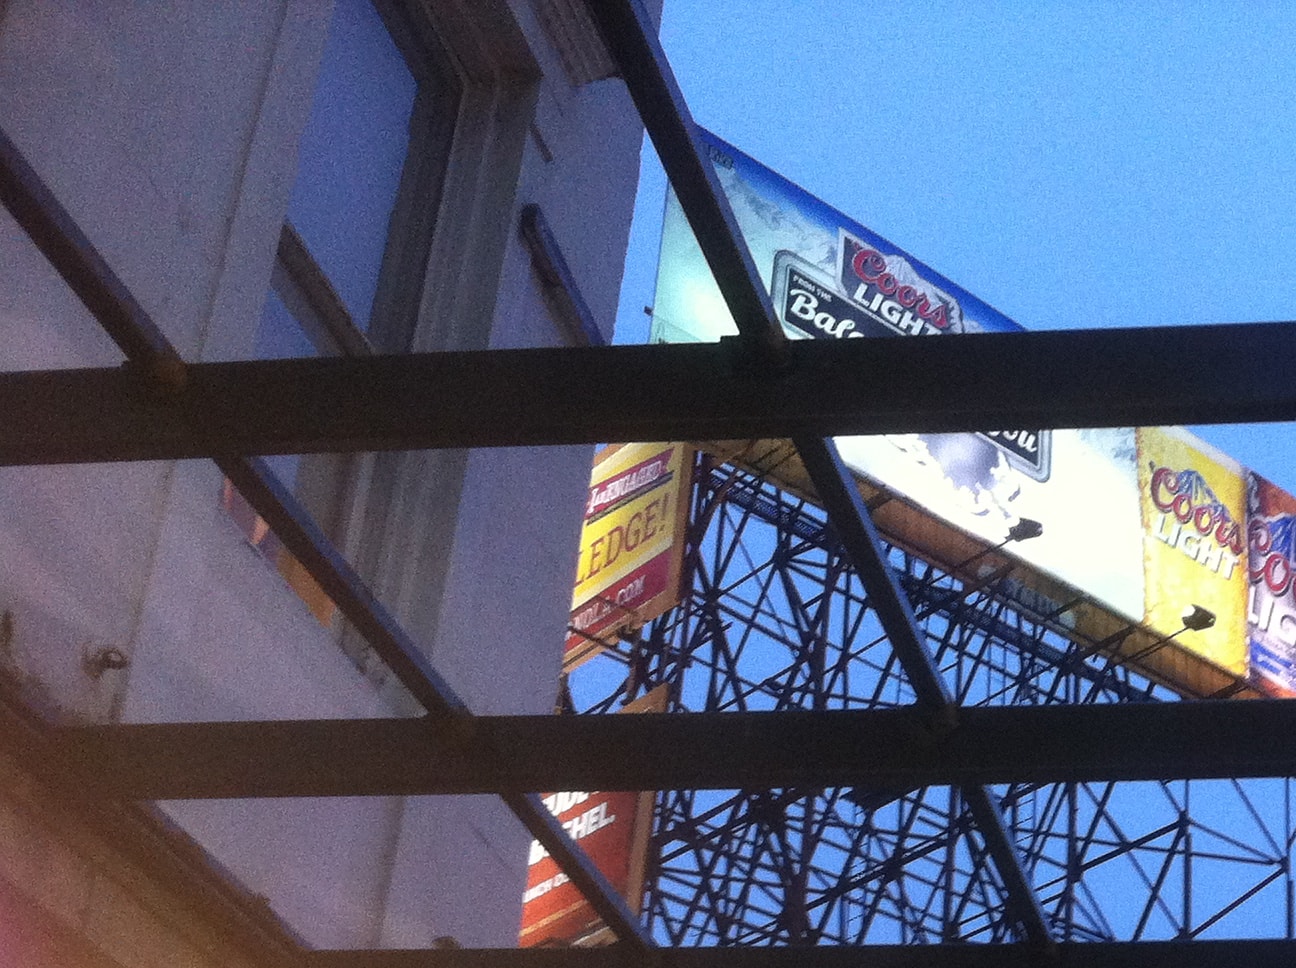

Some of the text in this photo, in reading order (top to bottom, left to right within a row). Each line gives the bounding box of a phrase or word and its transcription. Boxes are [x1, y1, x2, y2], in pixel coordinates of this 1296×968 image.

[853, 242, 949, 329] Coors
[574, 494, 671, 585] EDGE!
[1150, 463, 1243, 556] Coors
[1154, 516, 1240, 579] LIGHT
